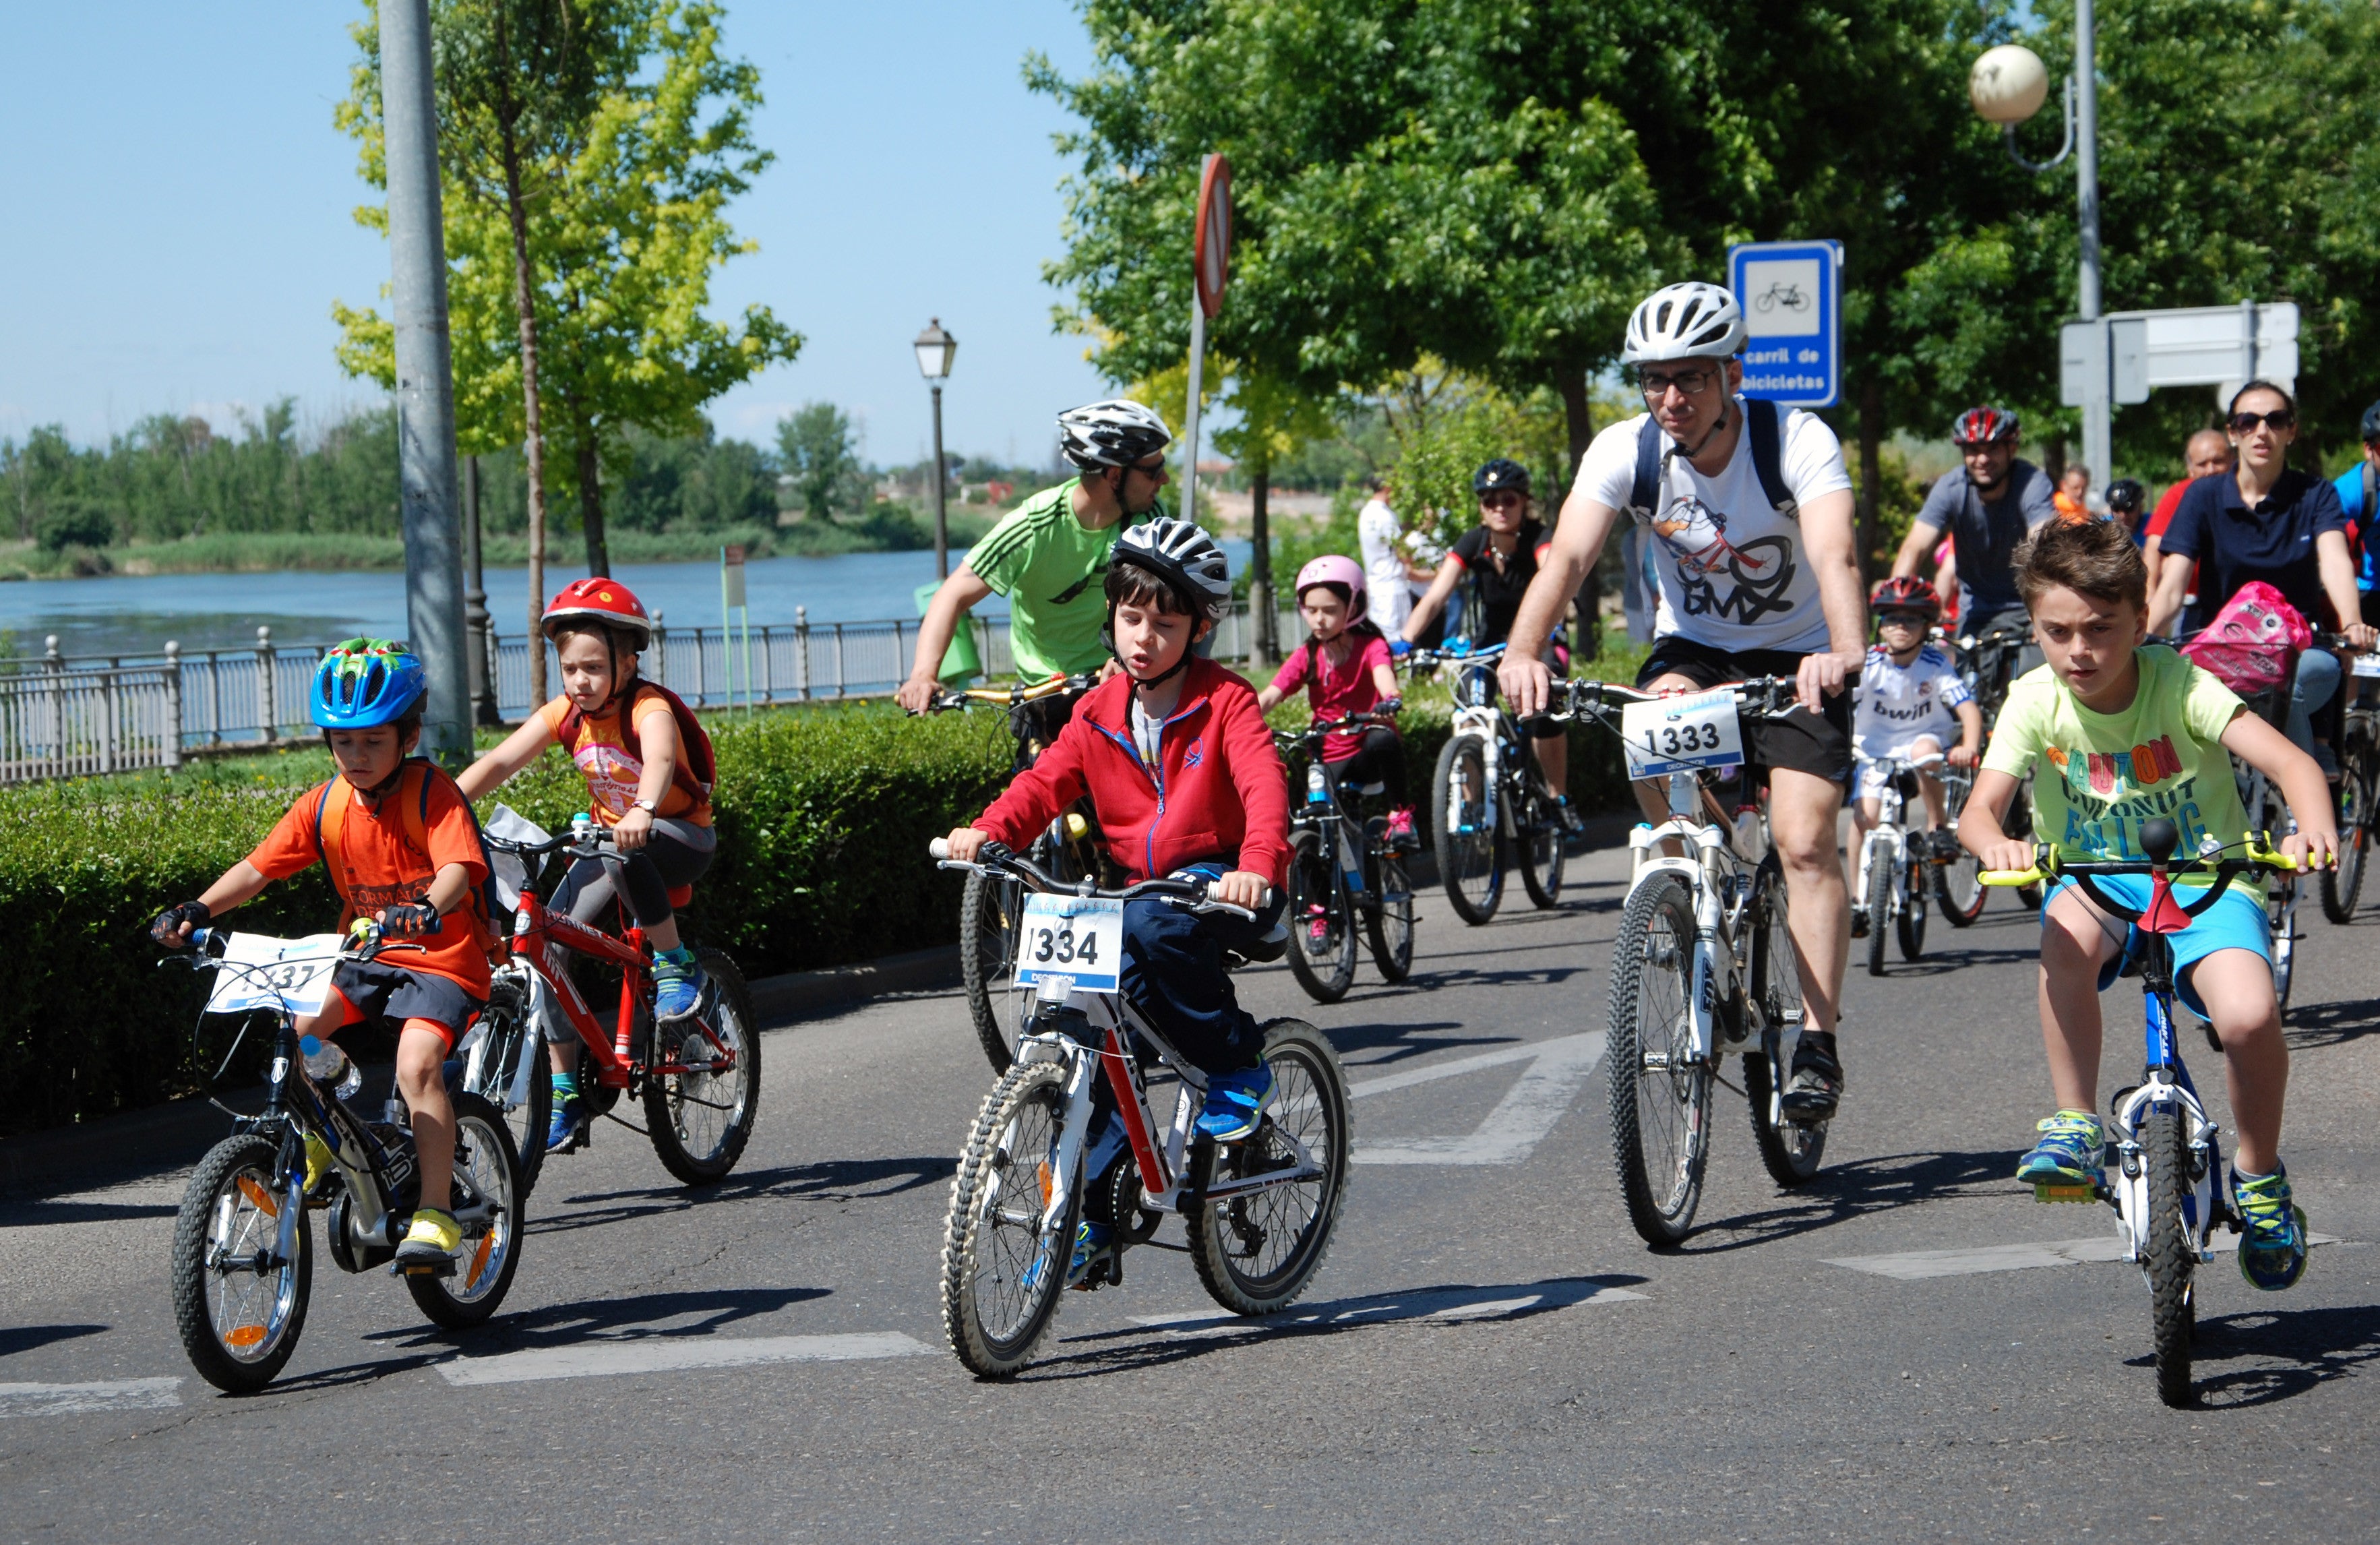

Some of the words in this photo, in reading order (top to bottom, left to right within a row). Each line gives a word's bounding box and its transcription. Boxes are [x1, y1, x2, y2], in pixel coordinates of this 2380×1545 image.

[1745, 347, 1790, 364] carril
[1797, 348, 1820, 364] de
[1740, 373, 1825, 390] bicicletas
[1674, 564, 1796, 626] BMX
[1874, 700, 1932, 721] bwin
[1645, 723, 1721, 757] 1333
